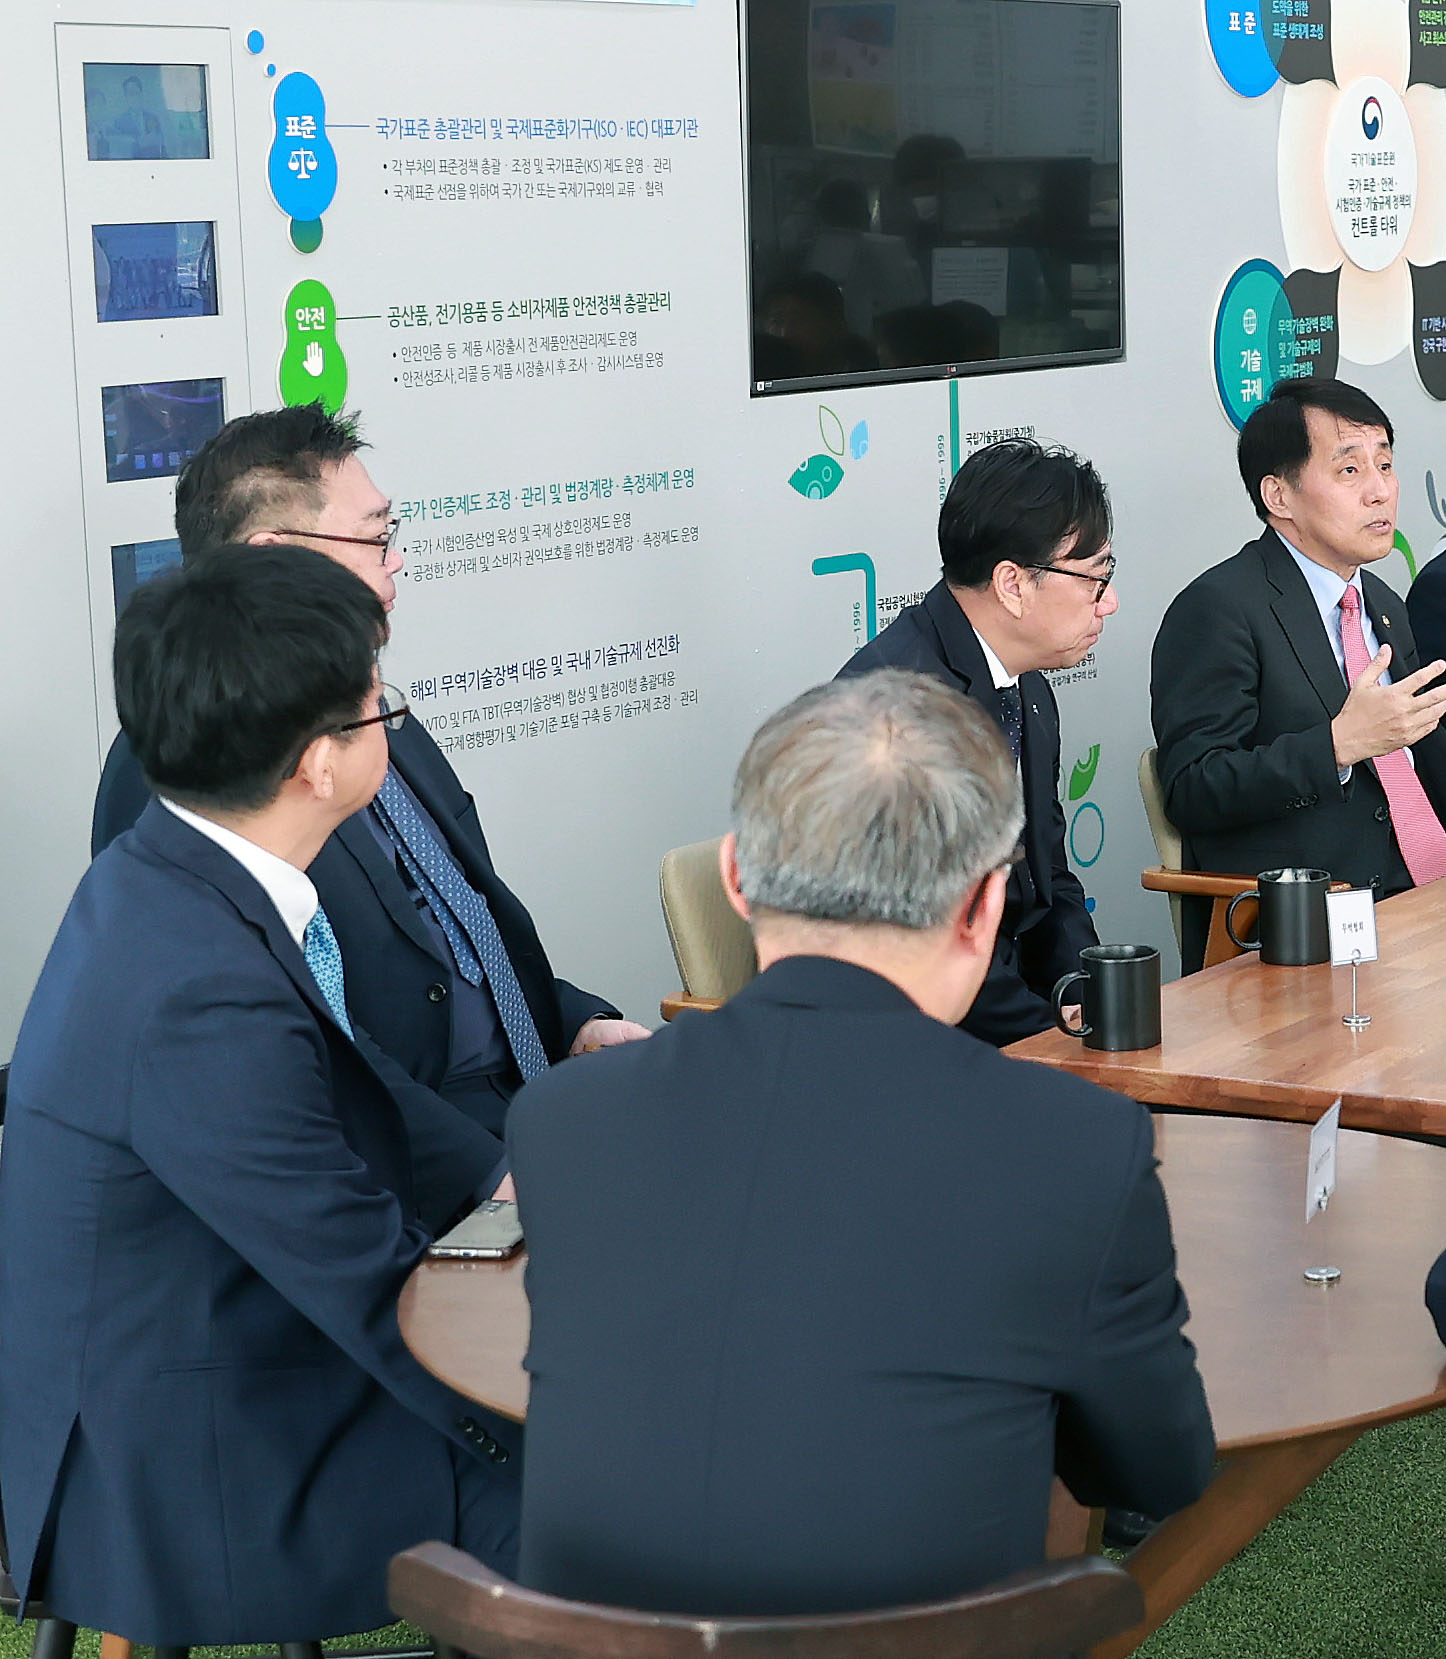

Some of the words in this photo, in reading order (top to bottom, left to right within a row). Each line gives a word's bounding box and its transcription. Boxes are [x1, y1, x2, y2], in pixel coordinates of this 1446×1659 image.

[1229, 12, 1256, 34] 표준
[1273, 22, 1287, 38] 표준
[1310, 23, 1323, 40] 조성
[285, 116, 316, 138] 표준
[376, 118, 430, 140] 국가표준
[434, 118, 486, 140] 총괄관리
[491, 119, 503, 139] 및
[652, 118, 698, 139] 대표기관
[392, 160, 402, 175] 각
[406, 159, 436, 175] 부처의
[439, 159, 478, 175] 표준정책
[482, 159, 500, 175] 총괄
[512, 158, 531, 175] 조정
[534, 159, 543, 174] 및
[604, 158, 623, 174] 제도
[625, 158, 644, 174] 운영
[653, 158, 671, 174] 관리
[393, 184, 434, 200] 국제표준
[437, 183, 467, 200] 선점을
[469, 183, 499, 199] 위하여
[502, 183, 521, 199] 국가
[525, 183, 534, 198] 간
[537, 183, 555, 198] 또는
[558, 182, 614, 198] 국제기구와의
[617, 182, 636, 197] 교류
[646, 181, 663, 197] 협력
[1348, 178, 1361, 193] 국가
[1363, 178, 1376, 192] 표준
[1352, 216, 1378, 237] 컨트롤
[1381, 215, 1397, 235] 타워
[296, 307, 326, 331] 안전
[387, 304, 432, 327] 공산품,
[436, 302, 488, 325] 전기용품
[491, 301, 504, 322] 등
[507, 297, 570, 319] 소비자제품
[573, 294, 621, 317] 안전정책
[624, 291, 671, 314] 총괄관리
[402, 344, 442, 363] 안전인증
[447, 343, 456, 359] 등
[462, 341, 483, 357] 제품
[486, 338, 525, 356] 시장출시
[528, 337, 537, 353] 전
[619, 331, 637, 347] 운영
[458, 365, 478, 383] 리콜
[481, 364, 490, 381] 등
[493, 363, 513, 379] 제품
[516, 360, 553, 378] 시장출시
[557, 359, 566, 374] 후
[569, 357, 587, 373] 조사
[597, 354, 644, 372] 감시시스템
[646, 352, 663, 368] 운영
[1240, 349, 1262, 372] 기술
[1240, 377, 1262, 402] 규제
[400, 500, 427, 522] 국가
[430, 494, 482, 519] 인증제도
[486, 489, 511, 510] 조정
[521, 485, 546, 507] 관리
[550, 483, 561, 504] 및
[566, 478, 613, 502] 법정계량
[622, 471, 669, 495] 측정체계
[672, 468, 694, 489] 운영
[412, 540, 431, 556] 국가
[436, 531, 494, 553] 시험인증산업
[497, 528, 516, 544] 육성
[520, 526, 529, 542] 및
[532, 523, 550, 539] 국제
[613, 512, 631, 529] 운영
[413, 562, 443, 582] 공정한
[446, 558, 477, 577] 상거래
[480, 556, 490, 572] 및
[492, 552, 521, 569] 소비자
[525, 544, 572, 566] 권익보호를
[575, 541, 594, 558] 위한
[596, 536, 633, 555] 법정계량
[681, 526, 699, 543] 운영
[410, 677, 437, 700] 해외
[441, 663, 519, 696] 무역기술장벽
[522, 658, 547, 680] 대응
[552, 655, 563, 677] 및
[566, 650, 591, 672] 국내
[595, 641, 642, 668] 기술규제
[645, 634, 680, 658] 선진화
[450, 712, 460, 728] 및
[463, 710, 480, 724] FTA
[568, 688, 586, 705] 협상
[589, 685, 598, 701] 및
[601, 678, 637, 699] 협정이행
[507, 725, 516, 742] 및
[520, 717, 558, 739] 기술기준
[582, 708, 600, 725] 구축
[603, 706, 612, 722] 등
[615, 698, 651, 720] 기술규제
[653, 695, 671, 711] 조정
[680, 689, 698, 707] 관리
